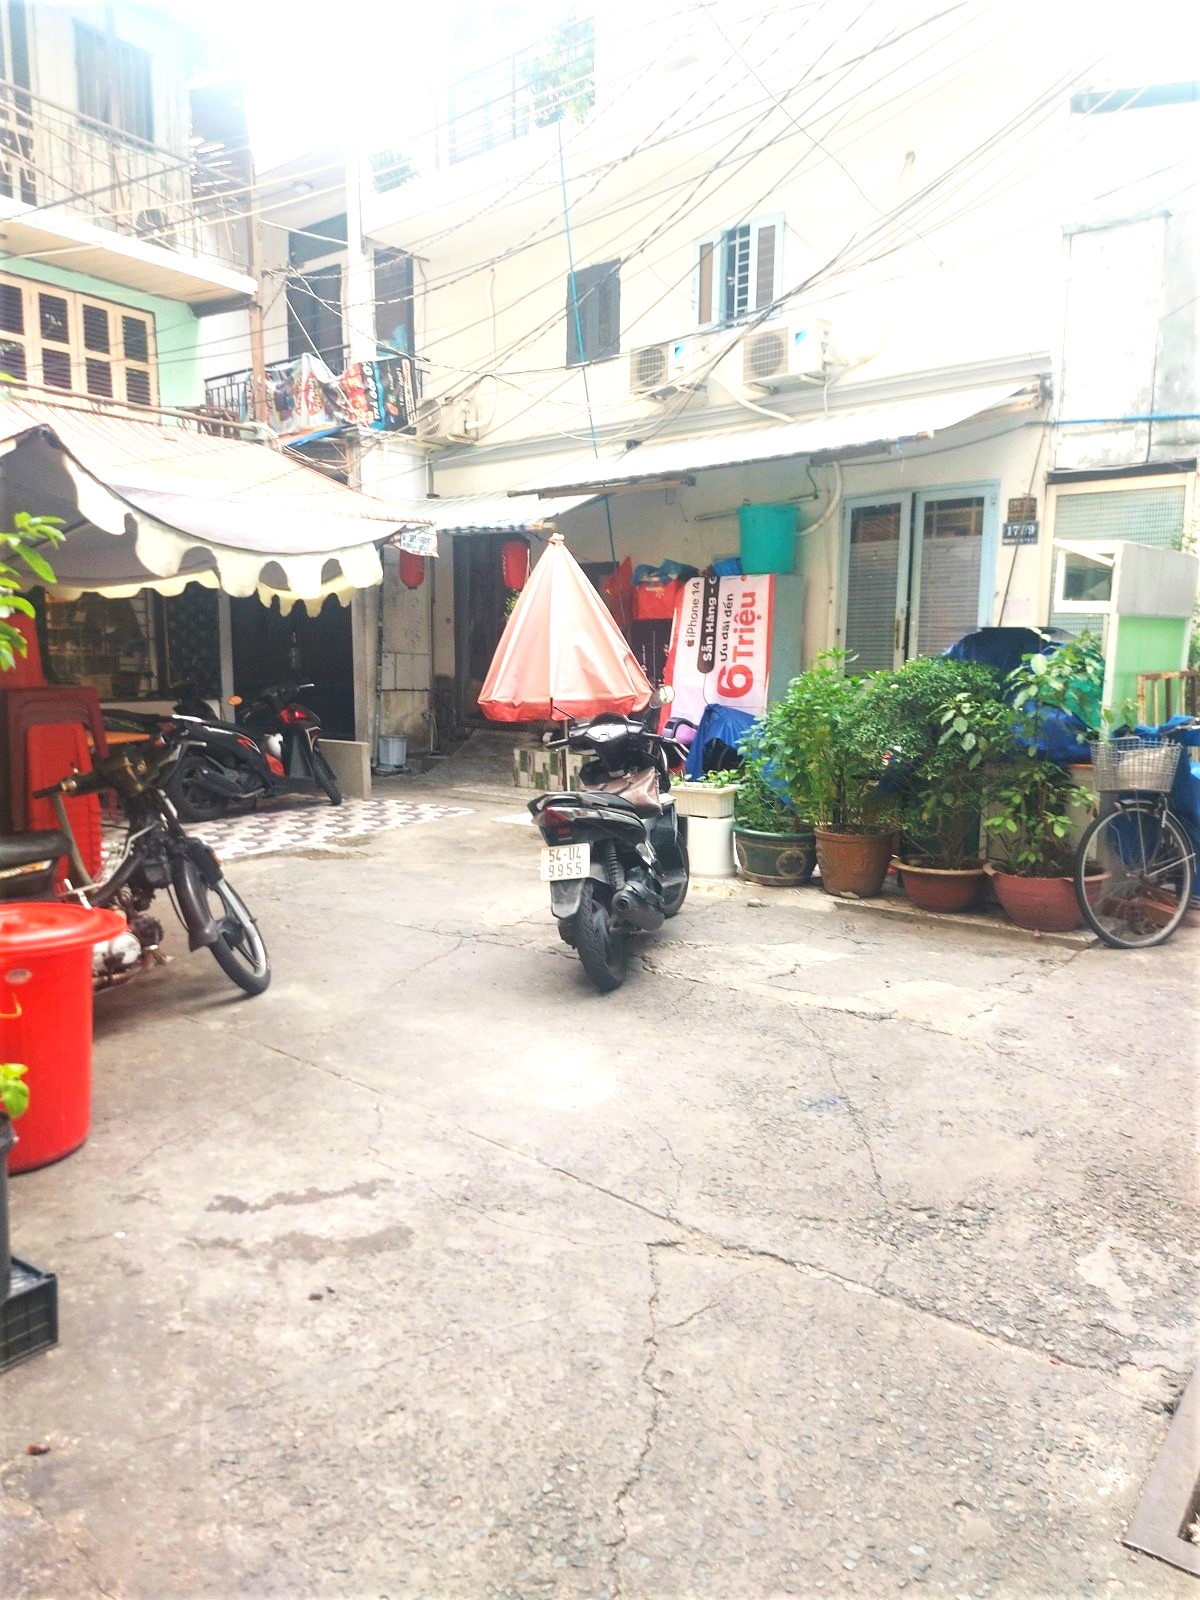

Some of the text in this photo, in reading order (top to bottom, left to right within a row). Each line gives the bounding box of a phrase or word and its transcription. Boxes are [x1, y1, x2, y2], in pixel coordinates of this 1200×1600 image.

[686, 581, 700, 637] iPhone 14
[720, 593, 734, 662] Ưu đãi đến
[701, 636, 713, 661] Sẵn
[717, 591, 761, 698] 6 Triệu
[549, 862, 582, 878] 9955
